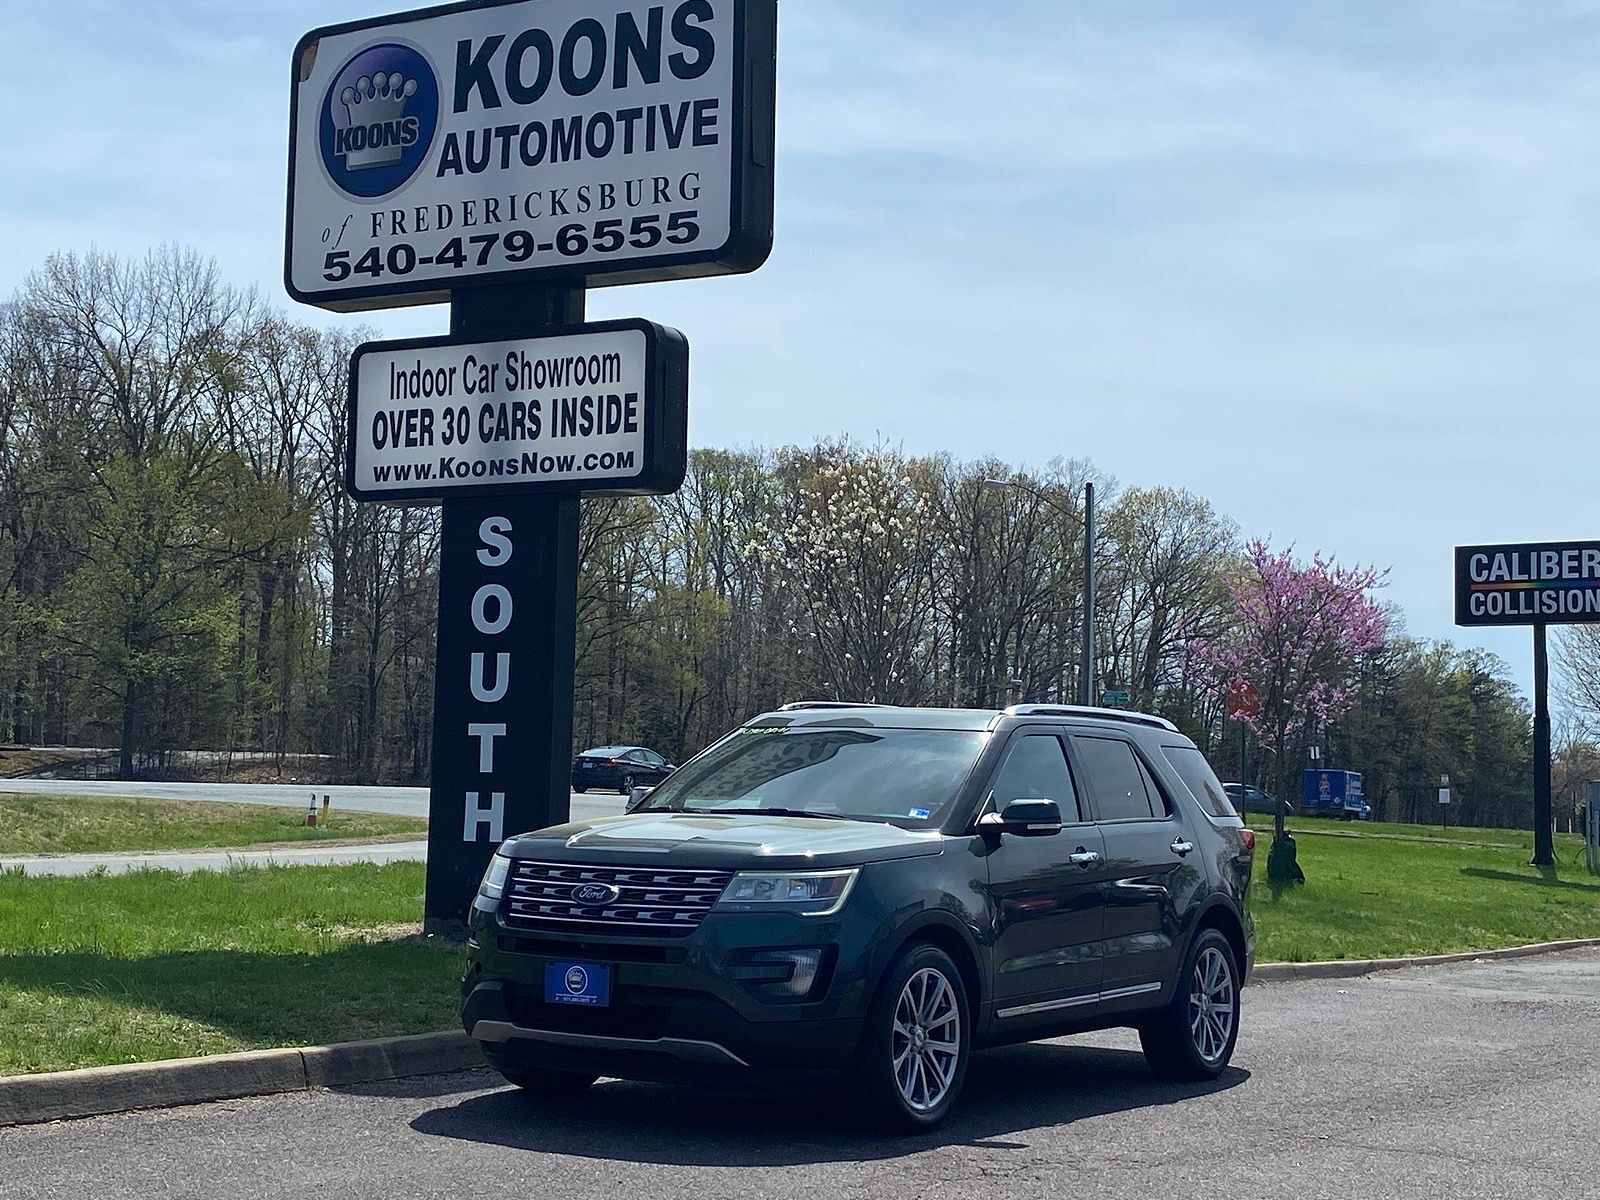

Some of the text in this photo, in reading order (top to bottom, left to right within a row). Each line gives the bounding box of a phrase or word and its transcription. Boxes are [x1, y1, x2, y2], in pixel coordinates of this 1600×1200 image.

[453, 0, 715, 113] KOONS
[336, 118, 418, 153] KOONS
[436, 98, 719, 177] AUTOMOTIVE
[321, 172, 701, 250] of FREDERICKSBURG
[323, 210, 700, 281] 540-479-6555
[390, 350, 621, 400] Indoor Car Showroom
[372, 393, 638, 450] OVER 30 CARS INSIDE
[1470, 549, 1600, 582] CALIBER
[1470, 589, 1600, 616] COLLISION
[463, 516, 513, 842] SOUTH
[579, 885, 607, 899] Ford
